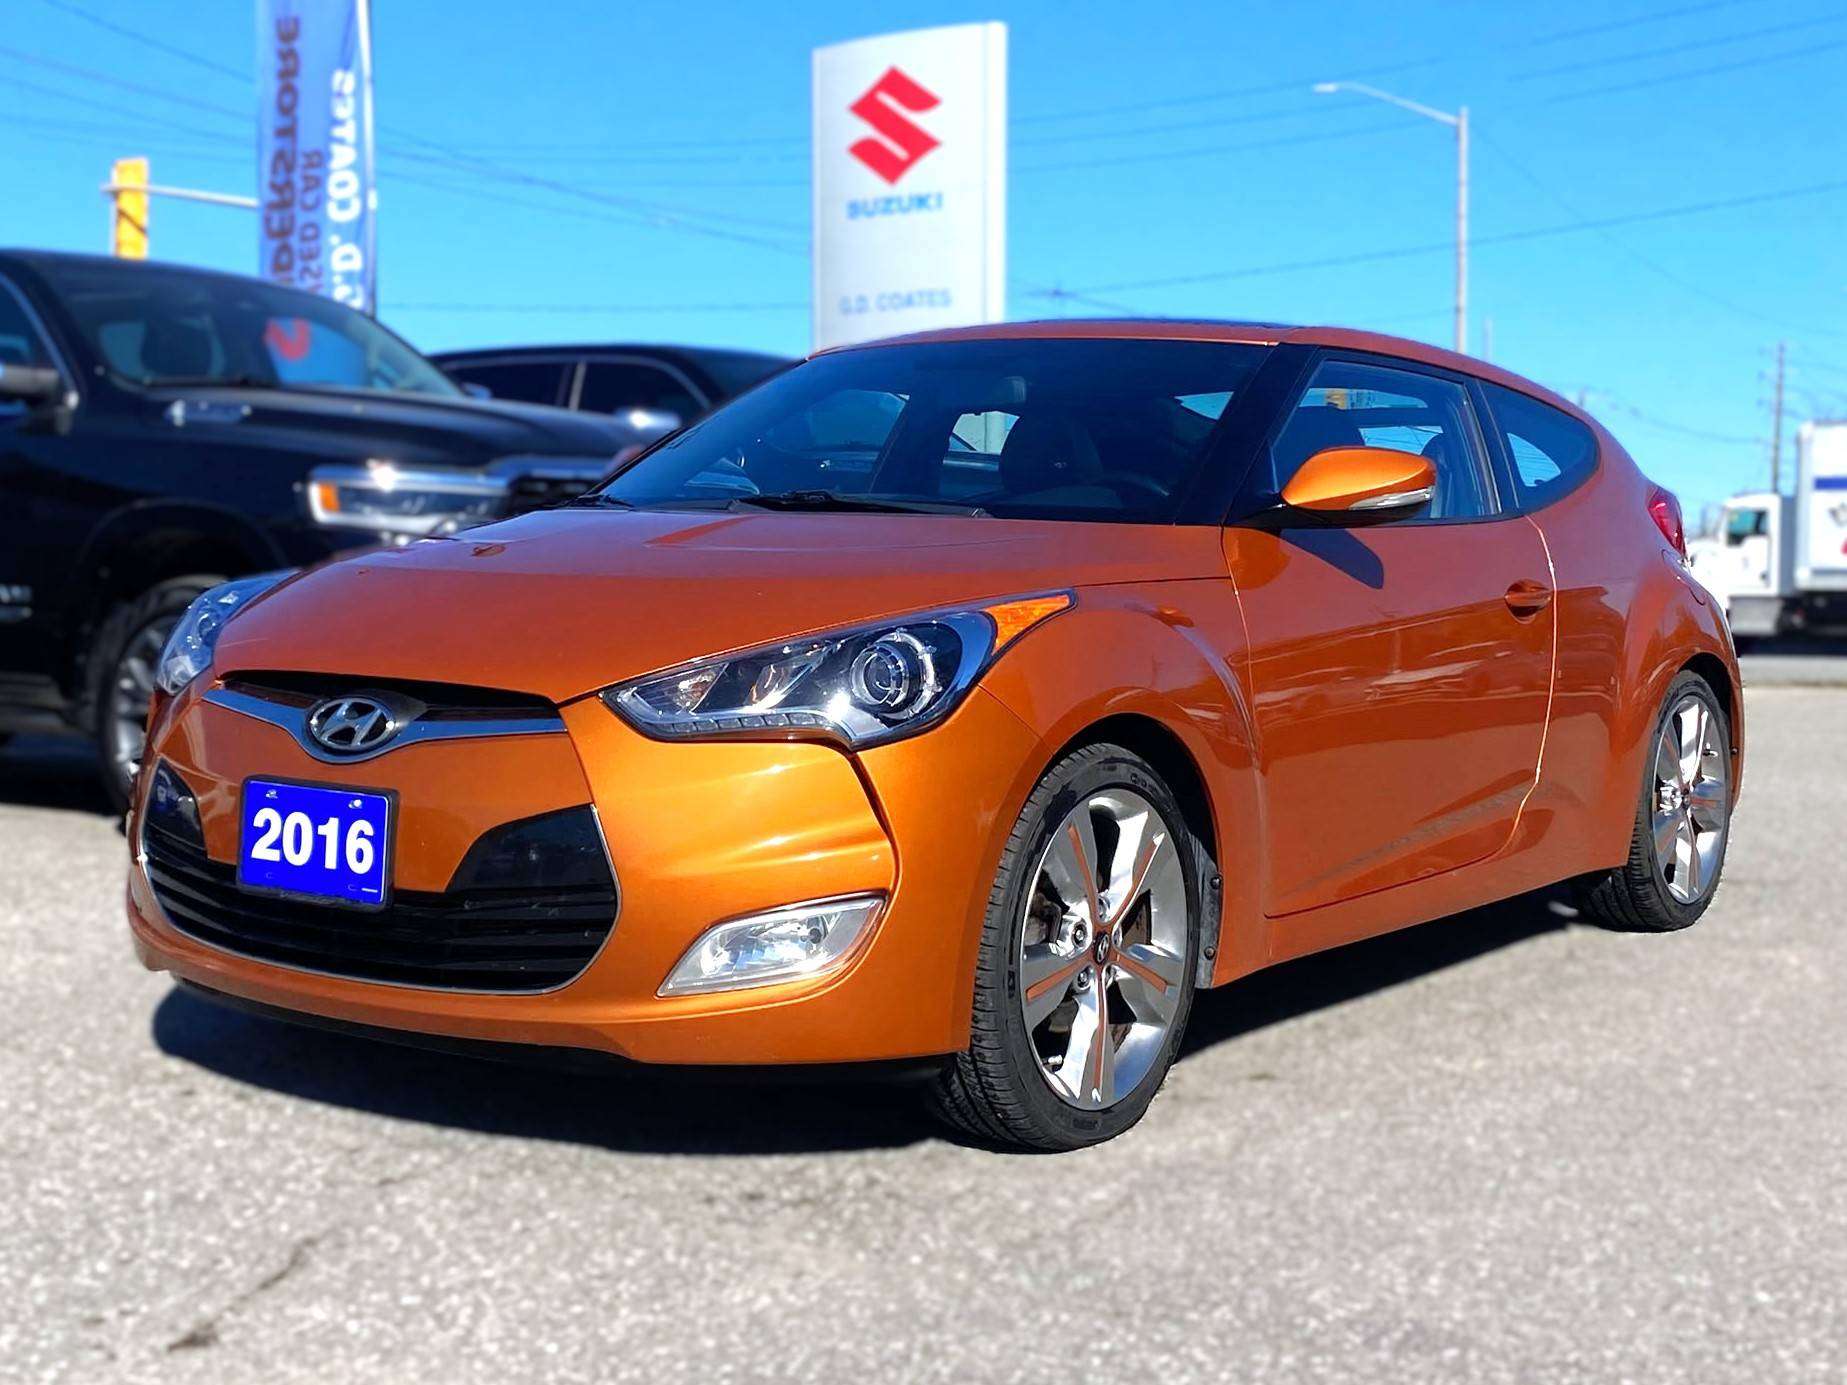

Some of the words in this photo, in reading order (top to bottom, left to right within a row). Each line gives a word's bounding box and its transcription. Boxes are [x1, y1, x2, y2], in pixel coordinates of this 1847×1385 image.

[846, 191, 944, 220] SUZUKI
[875, 288, 953, 312] COATES
[251, 807, 375, 875] 2016
